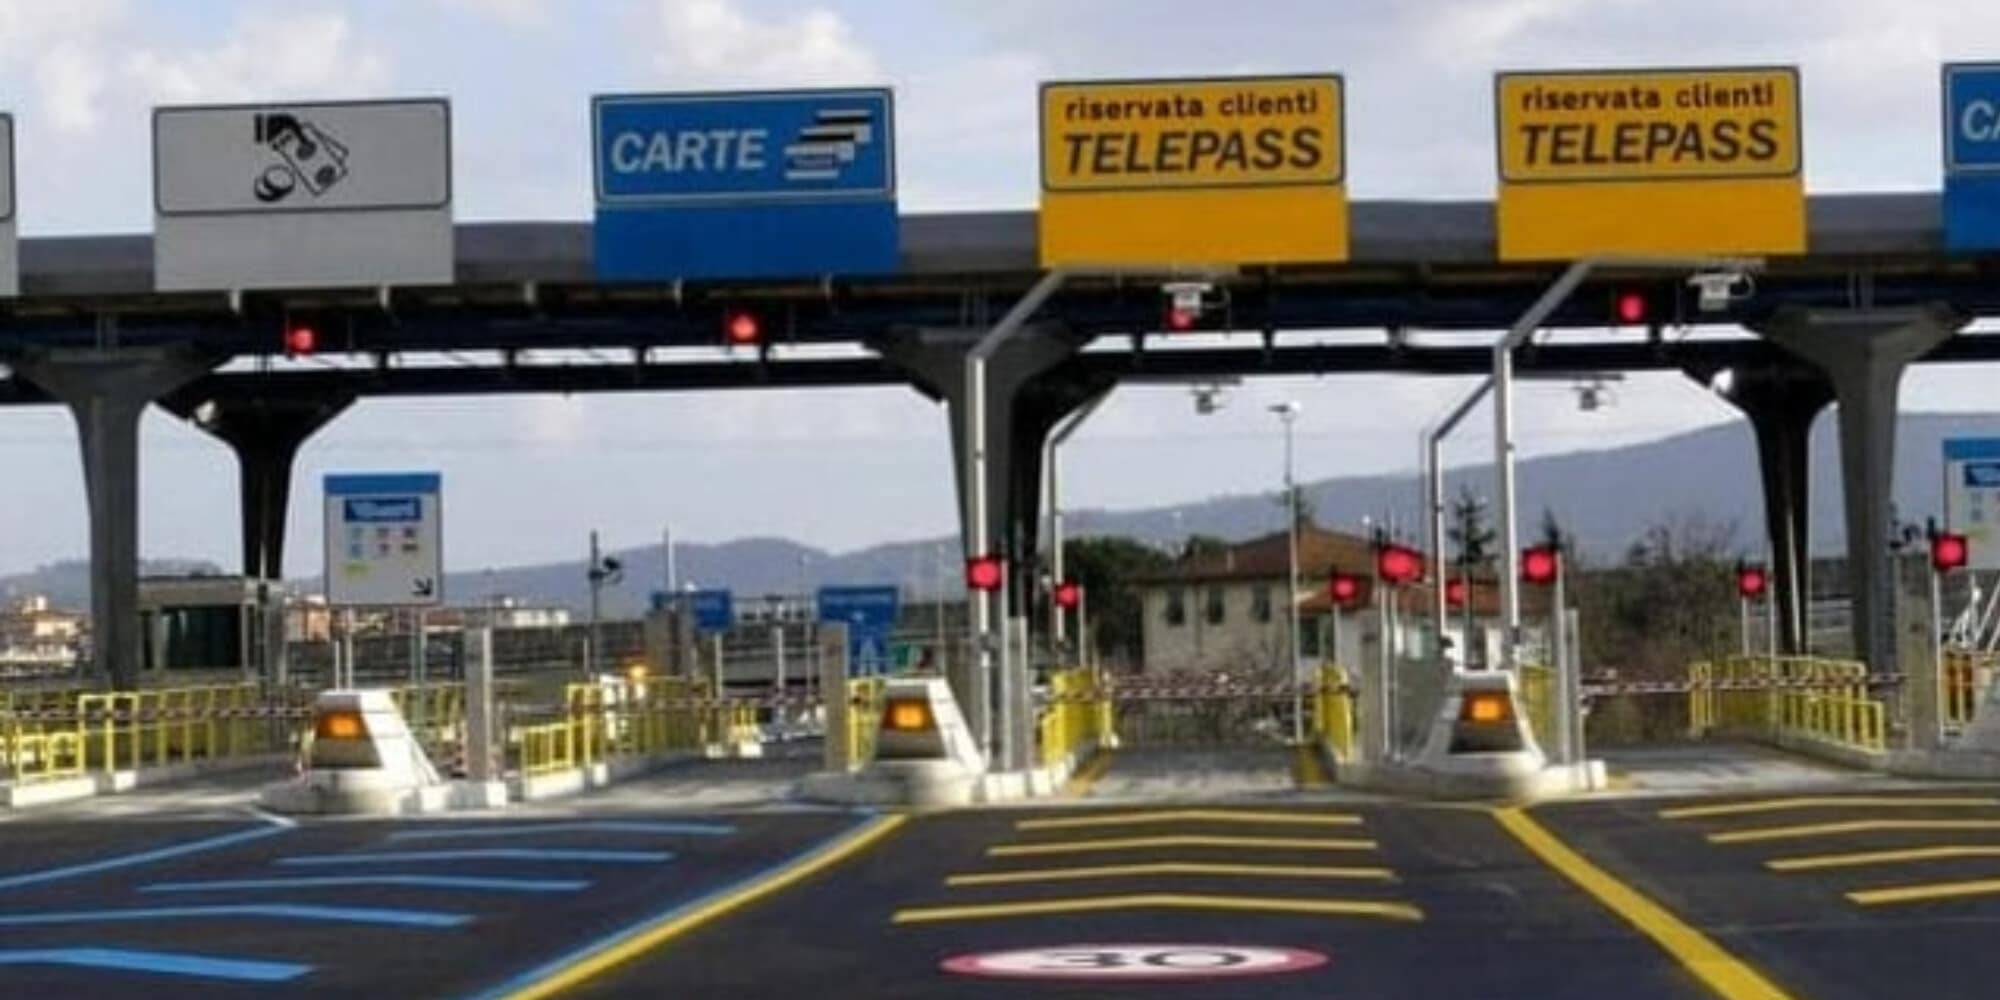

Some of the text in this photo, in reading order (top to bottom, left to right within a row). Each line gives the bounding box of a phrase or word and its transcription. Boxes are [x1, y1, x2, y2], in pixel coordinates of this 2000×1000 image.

[1065, 88, 1318, 120] riservata clienti
[1522, 80, 1774, 110] riservata clienti
[1961, 98, 2000, 141] C
[610, 128, 768, 174] CARTE
[1063, 127, 1322, 174] TELEPASS
[1520, 119, 1778, 166] TELEPASS
[1040, 949, 1249, 970] 30
